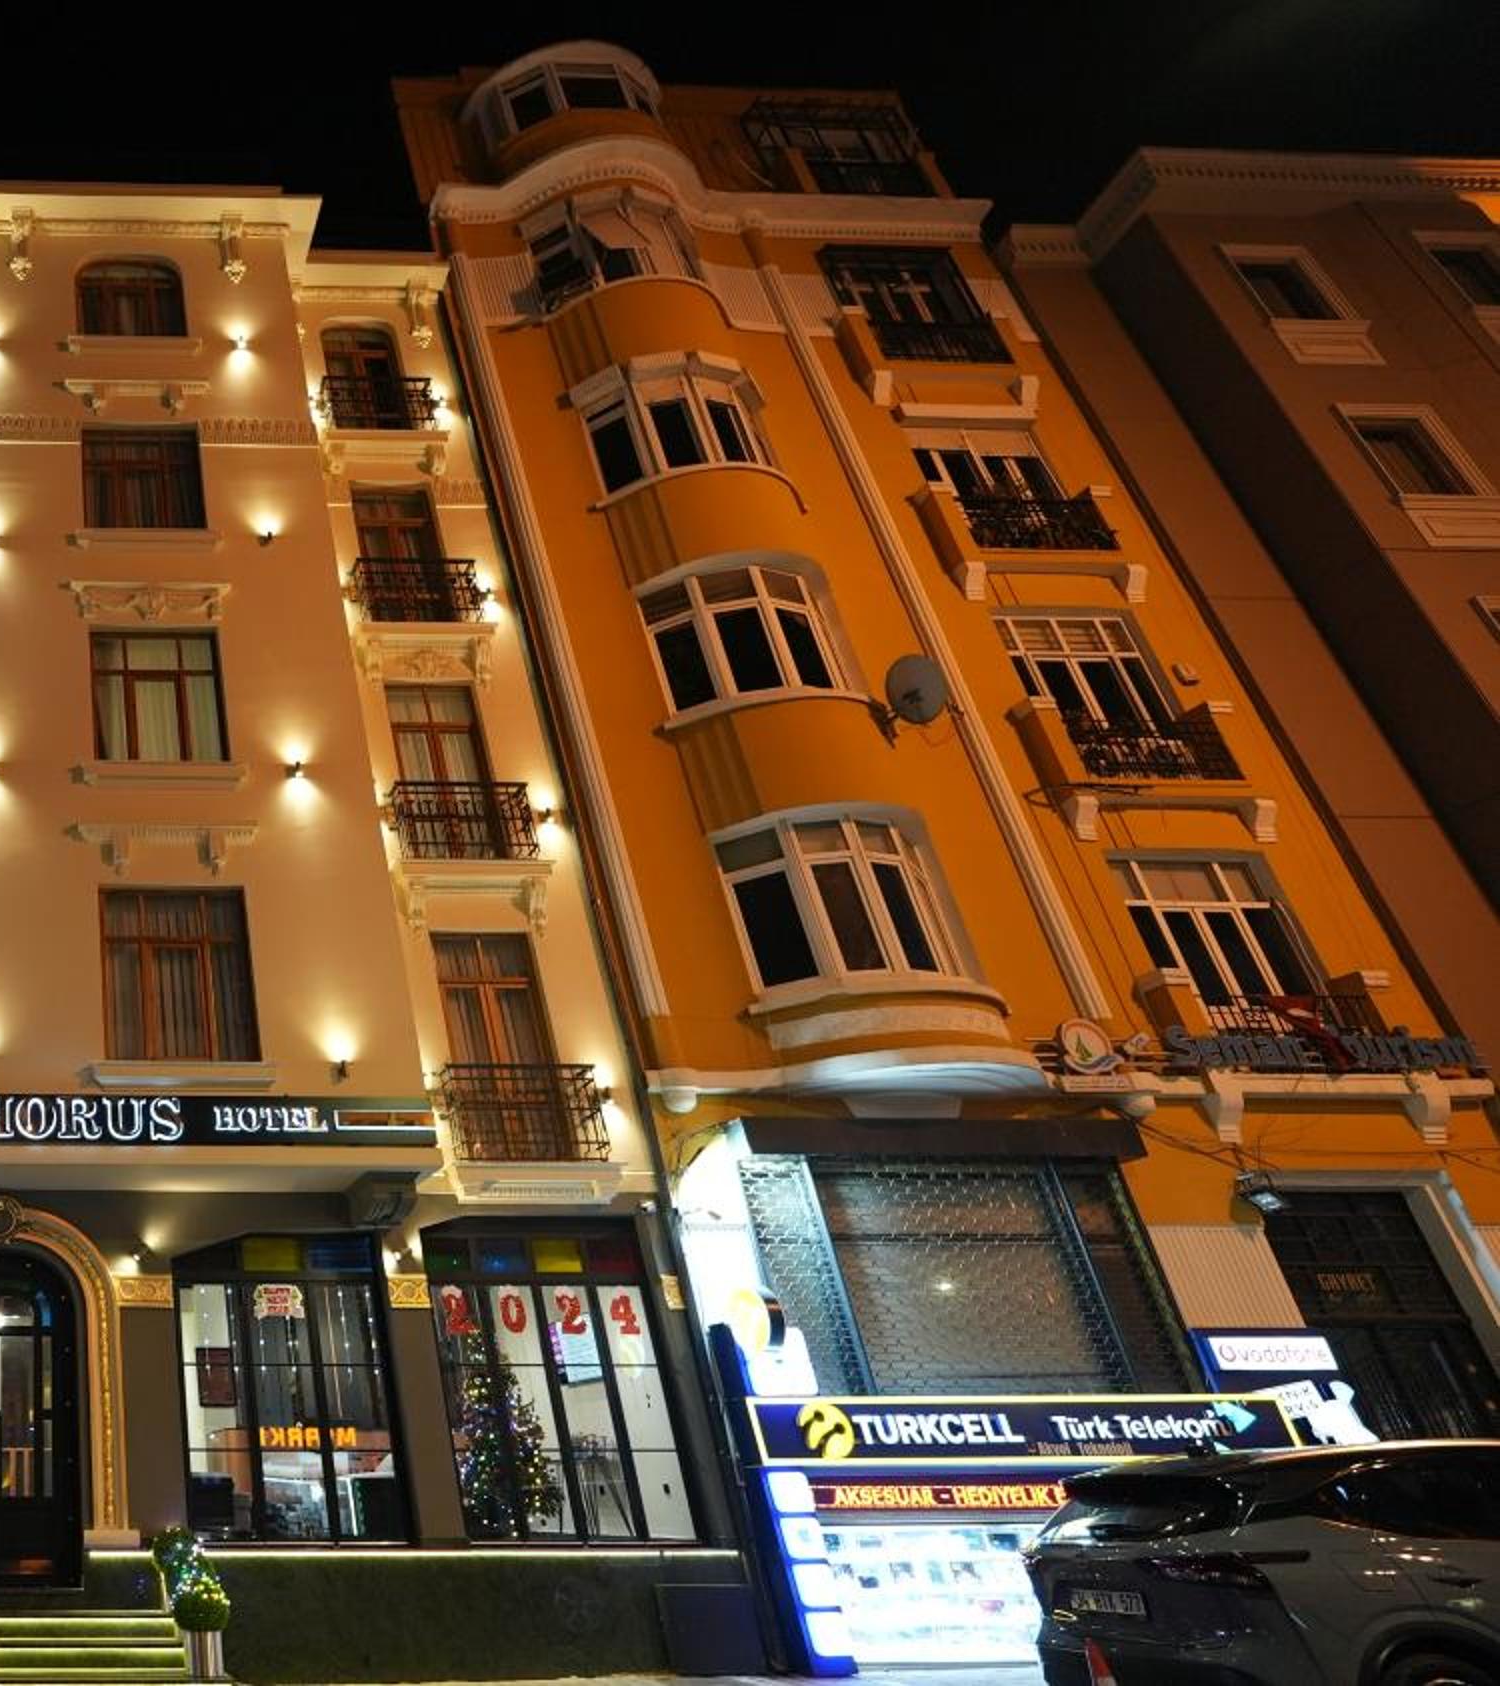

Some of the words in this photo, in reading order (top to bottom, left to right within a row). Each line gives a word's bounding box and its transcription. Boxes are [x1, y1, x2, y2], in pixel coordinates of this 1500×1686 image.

[213, 1106, 328, 1132] HOTEL
[441, 1284, 641, 1335] 2024
[851, 1414, 1025, 1444] TURKCELL
[1051, 1412, 1118, 1441] Türk
[1114, 1411, 1232, 1441] Telekom
[835, 1486, 935, 1508] AKSESUAR
